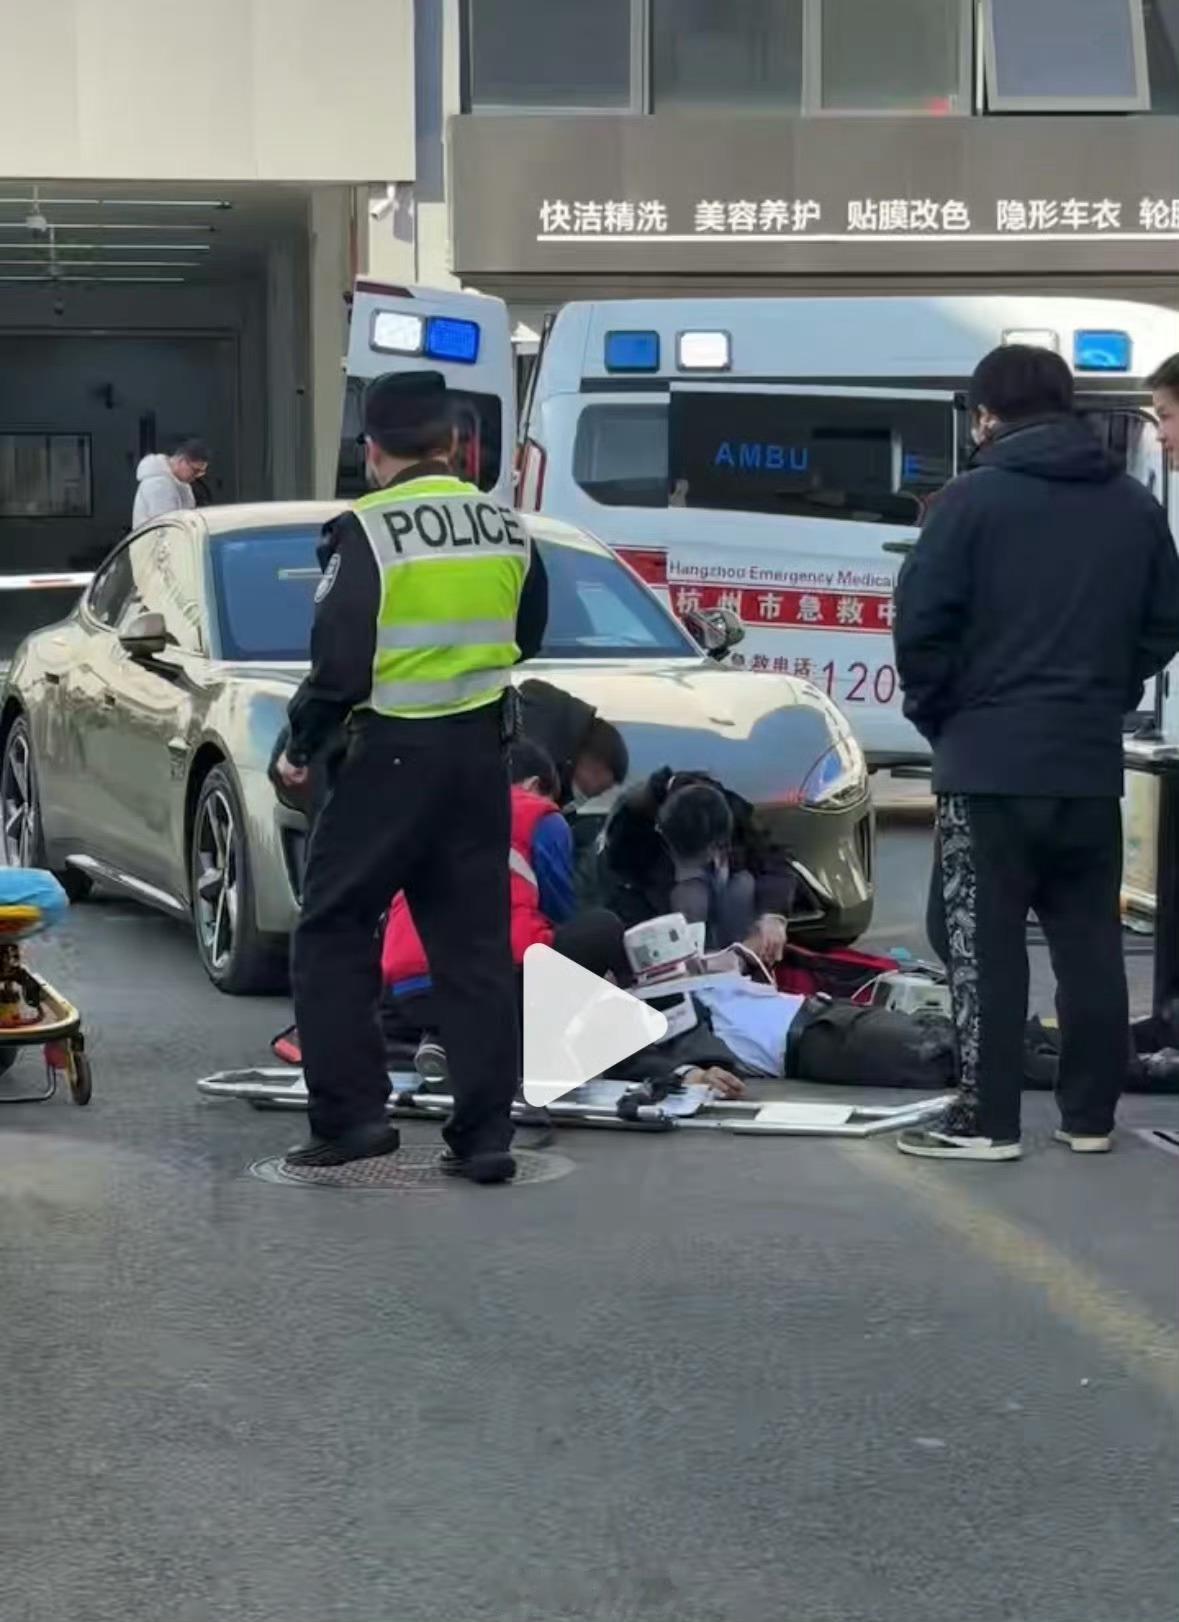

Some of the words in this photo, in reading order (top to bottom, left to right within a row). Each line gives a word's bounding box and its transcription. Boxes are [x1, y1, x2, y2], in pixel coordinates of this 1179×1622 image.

[539, 199, 669, 232] 快洁精洗
[695, 199, 822, 231] 美容养护
[847, 199, 971, 231] 贴膜改色
[996, 198, 1122, 230] 隐形车衣
[1138, 197, 1179, 230] 轮
[383, 503, 525, 553] POLICE
[669, 560, 745, 579] Hangzhou
[749, 566, 833, 585] Emergency
[837, 570, 897, 589] Medical
[822, 660, 897, 704] 120
